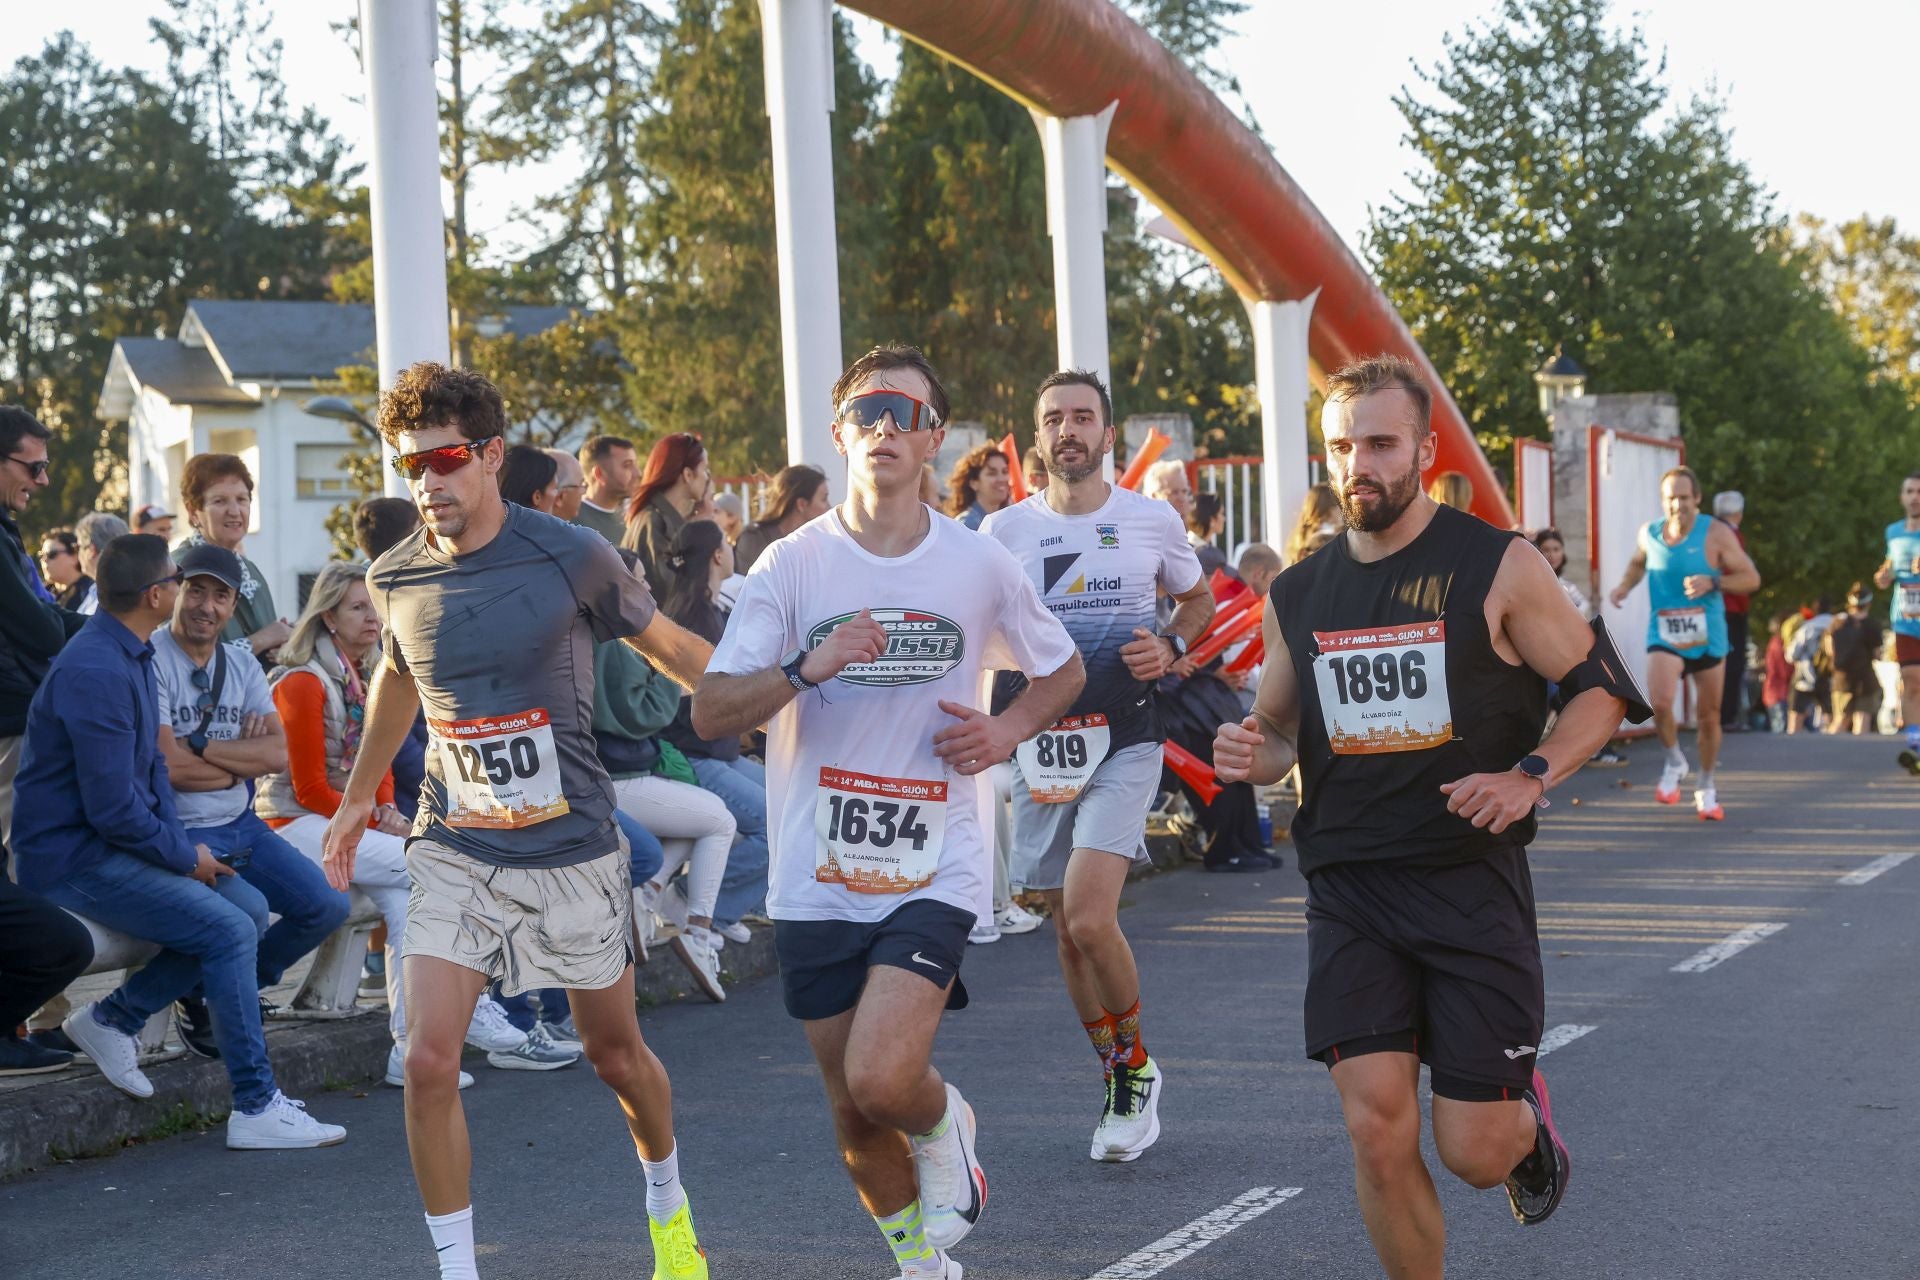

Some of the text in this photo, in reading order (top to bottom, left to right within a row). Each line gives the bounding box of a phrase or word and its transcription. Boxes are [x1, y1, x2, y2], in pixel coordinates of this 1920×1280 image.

[1040, 535, 1063, 548] GOBIK
[1046, 597, 1121, 613] arquitectura
[1666, 617, 1698, 633] 1914
[1352, 634, 1377, 645] MBA
[1398, 629, 1424, 641] GIJÓN
[1329, 649, 1428, 705] 1896
[1361, 710, 1402, 719] ÁLVARO DÍAZ
[499, 718, 527, 730] GIJÓN
[207, 730, 232, 739] STAR
[455, 726, 479, 735] MBA
[1036, 733, 1088, 768] 819
[446, 736, 540, 786] 1250
[853, 779, 880, 789] MBA
[901, 785, 928, 795] GIJÓN
[828, 795, 928, 851] 1634
[843, 852, 901, 864] ALEJANDRO DÍEZ
